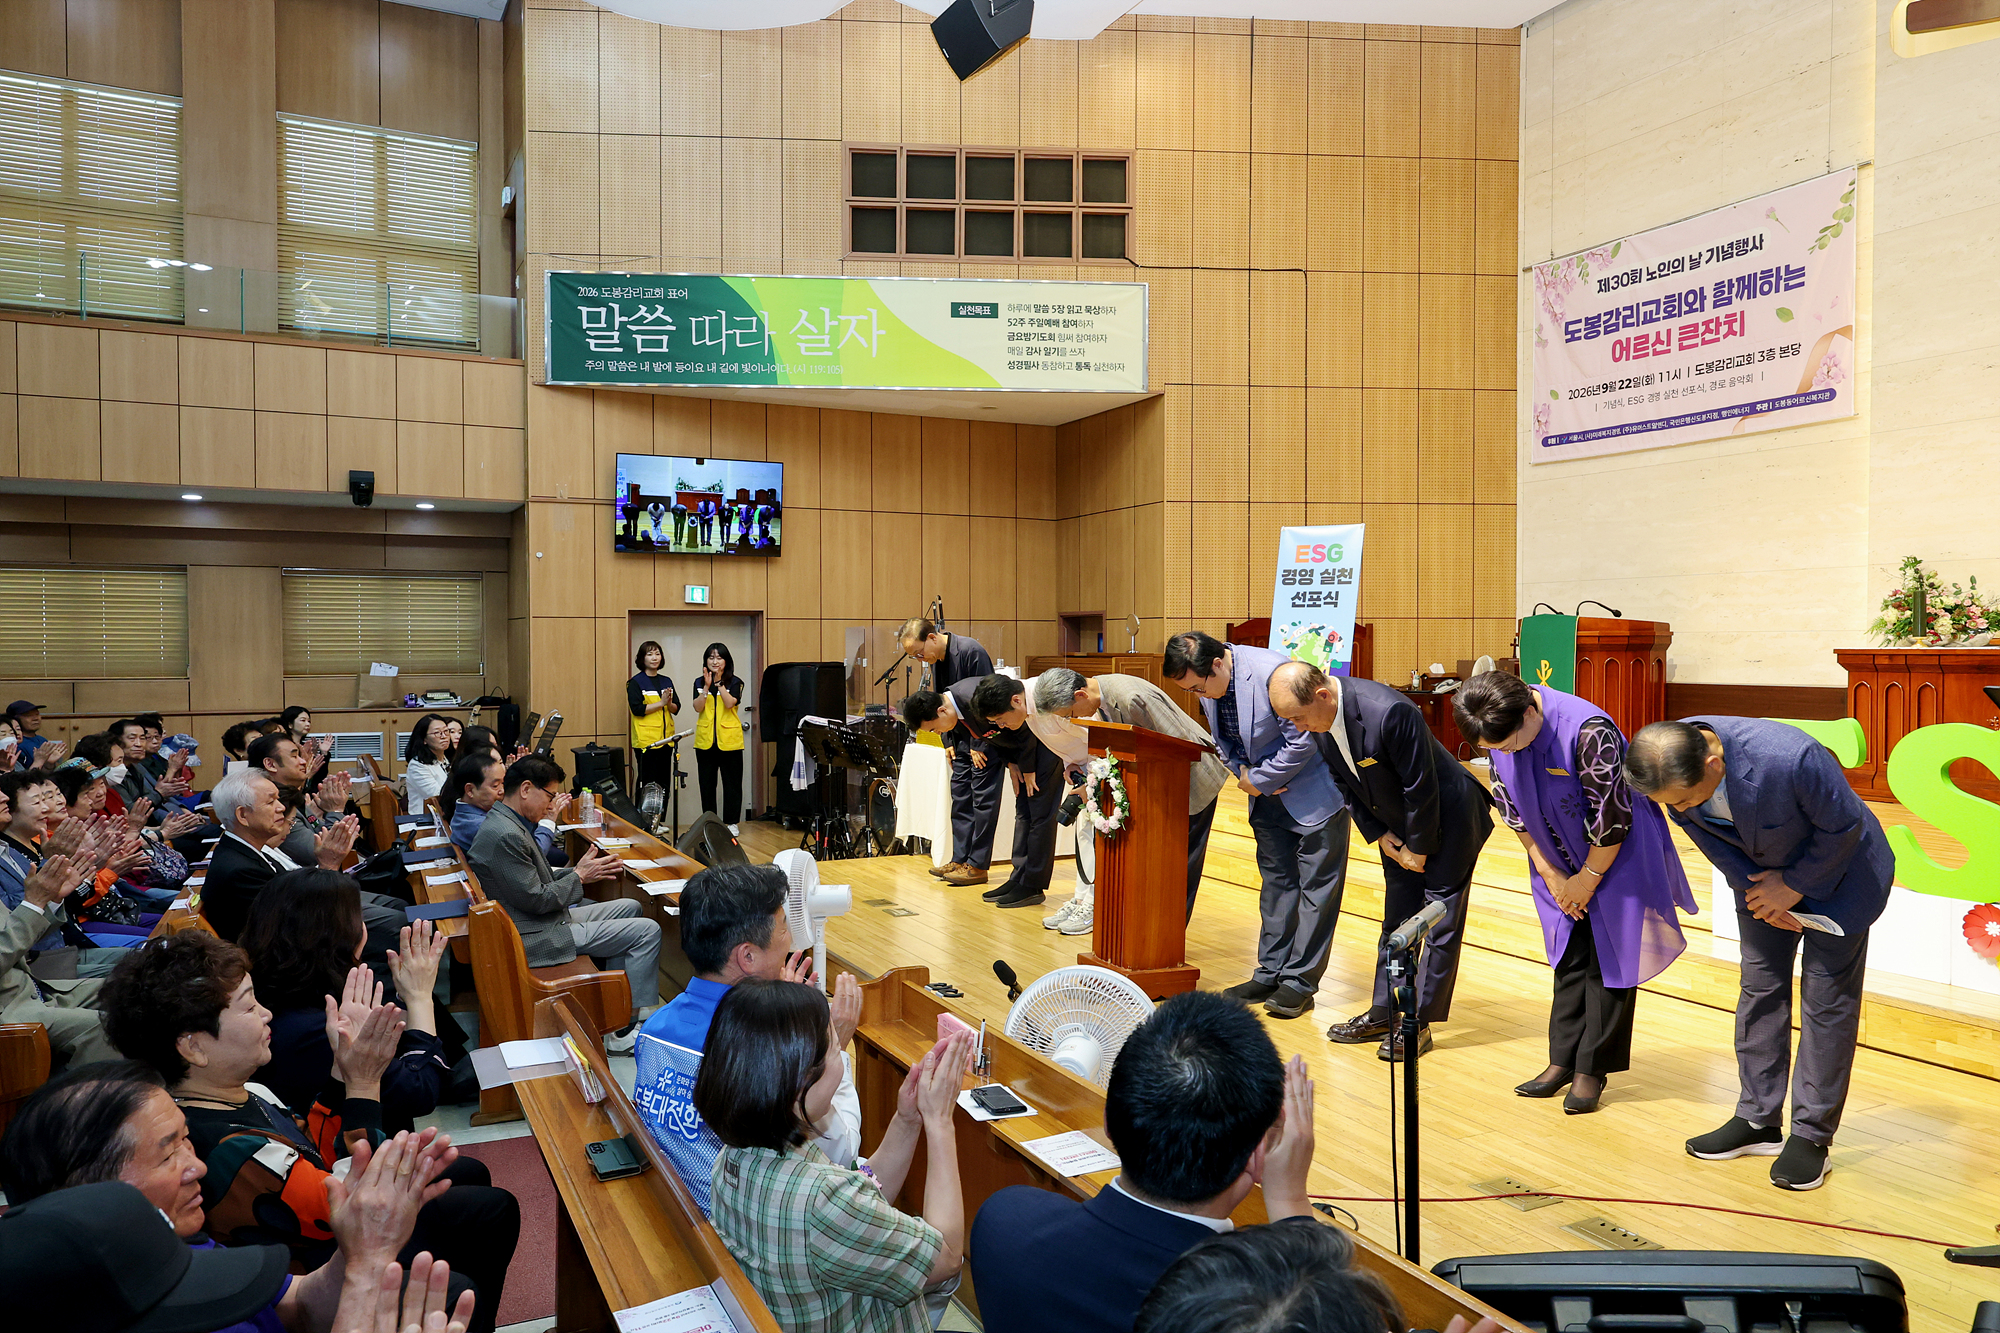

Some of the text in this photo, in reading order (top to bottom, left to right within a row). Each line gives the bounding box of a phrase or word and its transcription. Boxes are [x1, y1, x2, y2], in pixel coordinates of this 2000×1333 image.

[1597, 233, 1764, 294] 제30회 노인의 날 기념행사
[577, 286, 688, 300] 2026 도봉감리교회 표어
[957, 304, 992, 316] 실천목표
[1007, 303, 1117, 315] 하루에 말씀 5장 읽고 묵상하자
[1564, 263, 1806, 344] 도봉감리교회와 함께하는
[577, 302, 886, 358] 말씀 따라 살자
[1007, 318, 1094, 329] 52주 주일예배 참여하자
[1007, 332, 1107, 343] 금요밤기도회 힘써 참여하자
[1611, 310, 1745, 364] 어르신 큰잔치
[1007, 346, 1086, 357] 매일 감사 일기를 쓰자
[585, 360, 605, 371] 주의
[607, 360, 638, 372] 말씀은
[640, 361, 650, 372] 내
[652, 361, 672, 373] 발에
[674, 362, 705, 373] 등이요
[706, 362, 717, 373] 내
[719, 363, 739, 374] 길에
[1007, 360, 1125, 372] 성경필사 동참하고 통독 실천하자
[1568, 384, 1601, 400] 2026년
[1658, 368, 1681, 383] 11시
[1695, 352, 1755, 376] 도봉감리교회
[1757, 349, 1776, 363] 3층
[1779, 342, 1802, 358] 본당
[1627, 395, 1645, 406] ESG
[1663, 388, 1679, 401] 실천
[1681, 382, 1707, 397] 선포식,
[1709, 378, 1727, 391] 경로
[1729, 373, 1754, 388] 음악회
[1295, 543, 1343, 563] ESG
[1281, 567, 1353, 586] 경영 실천
[1290, 590, 1340, 608] 선포식
